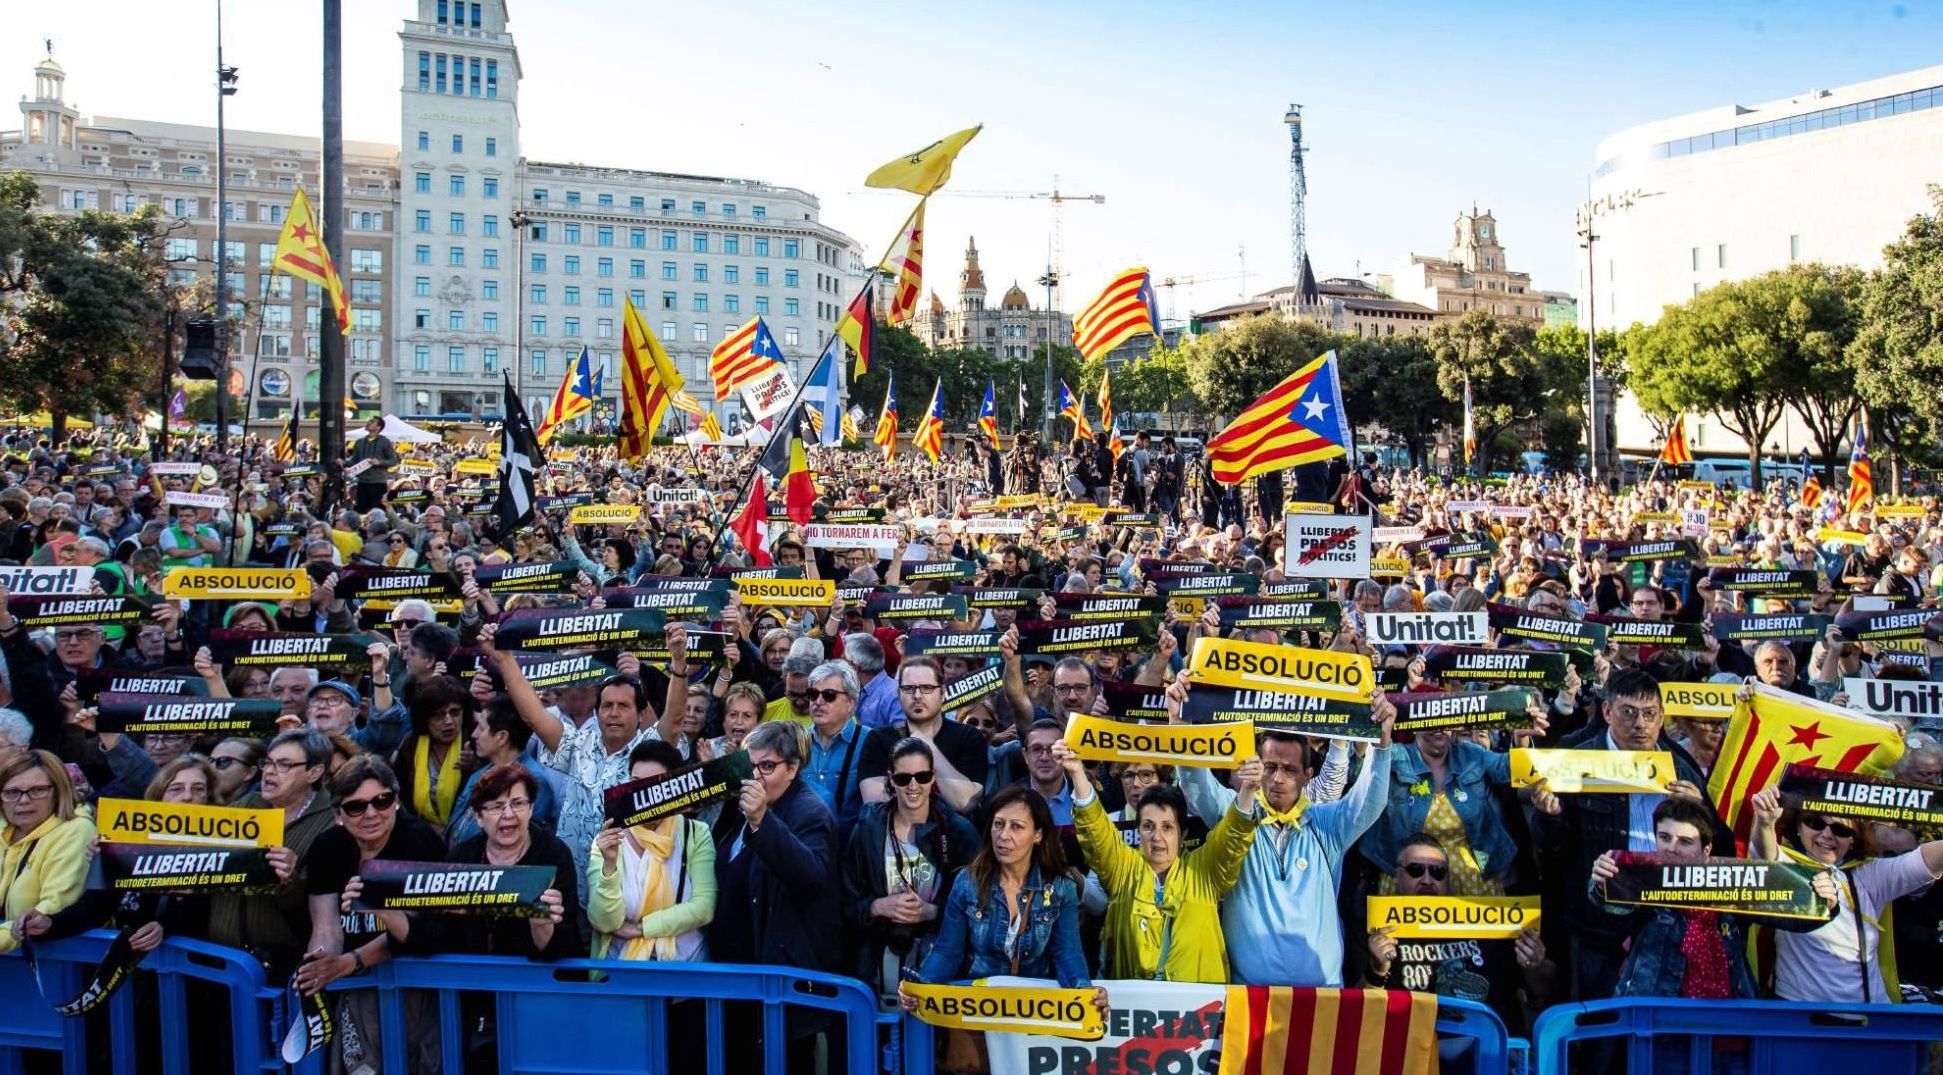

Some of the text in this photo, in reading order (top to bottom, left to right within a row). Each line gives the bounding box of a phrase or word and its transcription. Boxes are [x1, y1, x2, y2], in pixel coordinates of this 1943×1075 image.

[652, 489, 698, 502] Unitat!
[576, 508, 632, 519] ABSOLUCIÓ
[822, 528, 870, 538] TORNAREM
[874, 528, 879, 538] A
[882, 529, 898, 538] FER
[1301, 526, 1356, 536] LLIBERTAT
[1630, 542, 1675, 555] LLIBERTAT
[502, 564, 552, 580] LLIBERTAT
[914, 562, 956, 574] LLIBERTAT
[178, 574, 296, 589] ABSOLUCIÓ
[368, 575, 430, 590] LLIBERTAT
[1180, 576, 1234, 588] LLIBERTAT
[1736, 572, 1790, 583] LLIBERTAT
[739, 583, 826, 598] ABSOLUCIÓ
[974, 591, 1018, 600] LLIBERTAT
[39, 598, 125, 616] LLIBERTAT
[634, 593, 697, 608] LLIBERTAT
[890, 598, 944, 610] LLIBERTAT
[1082, 598, 1141, 612] LLIBERTAT
[112, 612, 121, 620] UN
[1249, 604, 1313, 618] LLIBERTAT
[540, 613, 623, 636] LLIBERTAT
[1376, 614, 1477, 642] Unitat!
[1517, 616, 1583, 635] LLIBERTAT
[1742, 616, 1804, 630] LLIBERTAT
[523, 630, 639, 647] L'AUTODETERMINACIÓ ÉS UN DRET
[1053, 622, 1124, 643] LLIBERTAT
[251, 638, 332, 655] LLIBERTAT
[935, 635, 992, 647] LLIBERTAT
[1114, 638, 1122, 646] UN
[522, 656, 592, 679] LLIBERTAT
[1205, 649, 1362, 687] ABSOLUCIÓ
[1456, 655, 1530, 669] LLIBERTAT
[111, 678, 186, 693] LLIBERTAT
[945, 666, 1000, 701] LLIBERTAT
[1234, 690, 1327, 711] LLIBERTAT
[1410, 695, 1488, 719] LLIBERTAT
[144, 703, 236, 722] LLIBERTAT
[1213, 710, 1350, 724] L'AUTODETERMINACIÓ ÉS UN DRET
[1478, 714, 1488, 722] UN
[126, 720, 250, 732] L'AUTODETERMINACIÓ ÉS UN DRET
[1080, 728, 1236, 756] ABSOLUCIÓ
[633, 768, 705, 811] LLIBERTAT
[1825, 781, 1934, 810] LLIBERTAT
[624, 782, 727, 826] L'AUTODETERMINACIÓ ÉS UN DRET
[1803, 802, 1929, 822] L'AUTODETERMINACIÓ ÉS UN
[112, 811, 260, 840] ABSOLUCIÓ
[132, 852, 230, 876] LLIBERTAT
[115, 876, 247, 888] L'AUTODETERMINACIÓ ÉS UN DRET
[404, 870, 504, 894] LLIBERTAT
[1662, 866, 1768, 888] LLIBERTAT
[384, 893, 519, 908] L'AUTODETERMINACIÓ ÉS UN DRET
[1641, 889, 1793, 901] L'AUTODETERMINACIÓ ÉS UN DRET
[1386, 902, 1524, 924] ABSOLUCIÓ
[1398, 940, 1482, 962] ROCKERS
[924, 996, 1085, 1022] ABSOLUCIÓ
